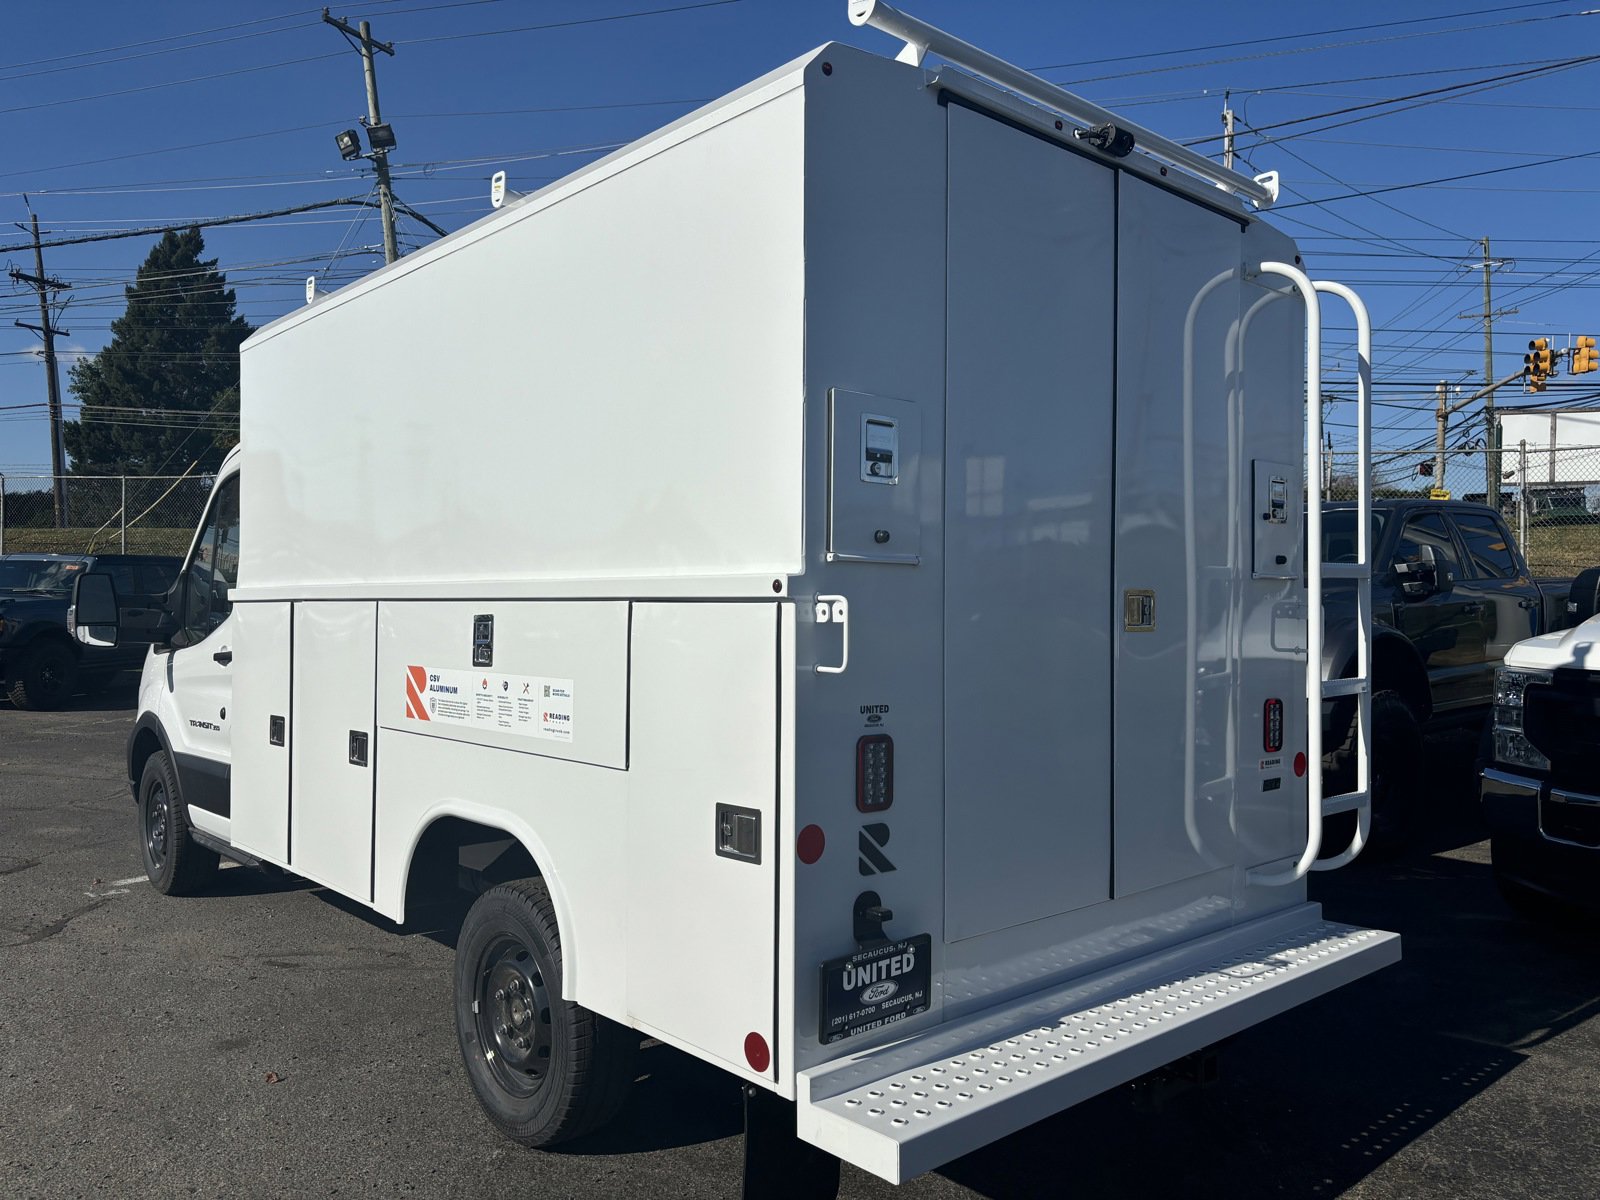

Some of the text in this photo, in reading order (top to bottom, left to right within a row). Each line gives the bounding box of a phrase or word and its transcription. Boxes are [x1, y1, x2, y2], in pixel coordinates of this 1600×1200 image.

[430, 674, 440, 682] CSV
[429, 684, 458, 694] ALUMINUM
[860, 704, 890, 714] UNITED
[549, 712, 570, 722] READING
[189, 720, 213, 729] TRANSIT
[852, 942, 907, 962] SECAUCUS, NJ
[842, 954, 915, 991] UNITED
[868, 985, 890, 1000] Ford
[831, 1015, 847, 1026] (201)
[849, 1006, 876, 1020] 617-0700
[881, 995, 914, 1010] SECAUCUS,
[915, 990, 923, 998] NJ
[850, 1012, 906, 1035] UNITED FORD
